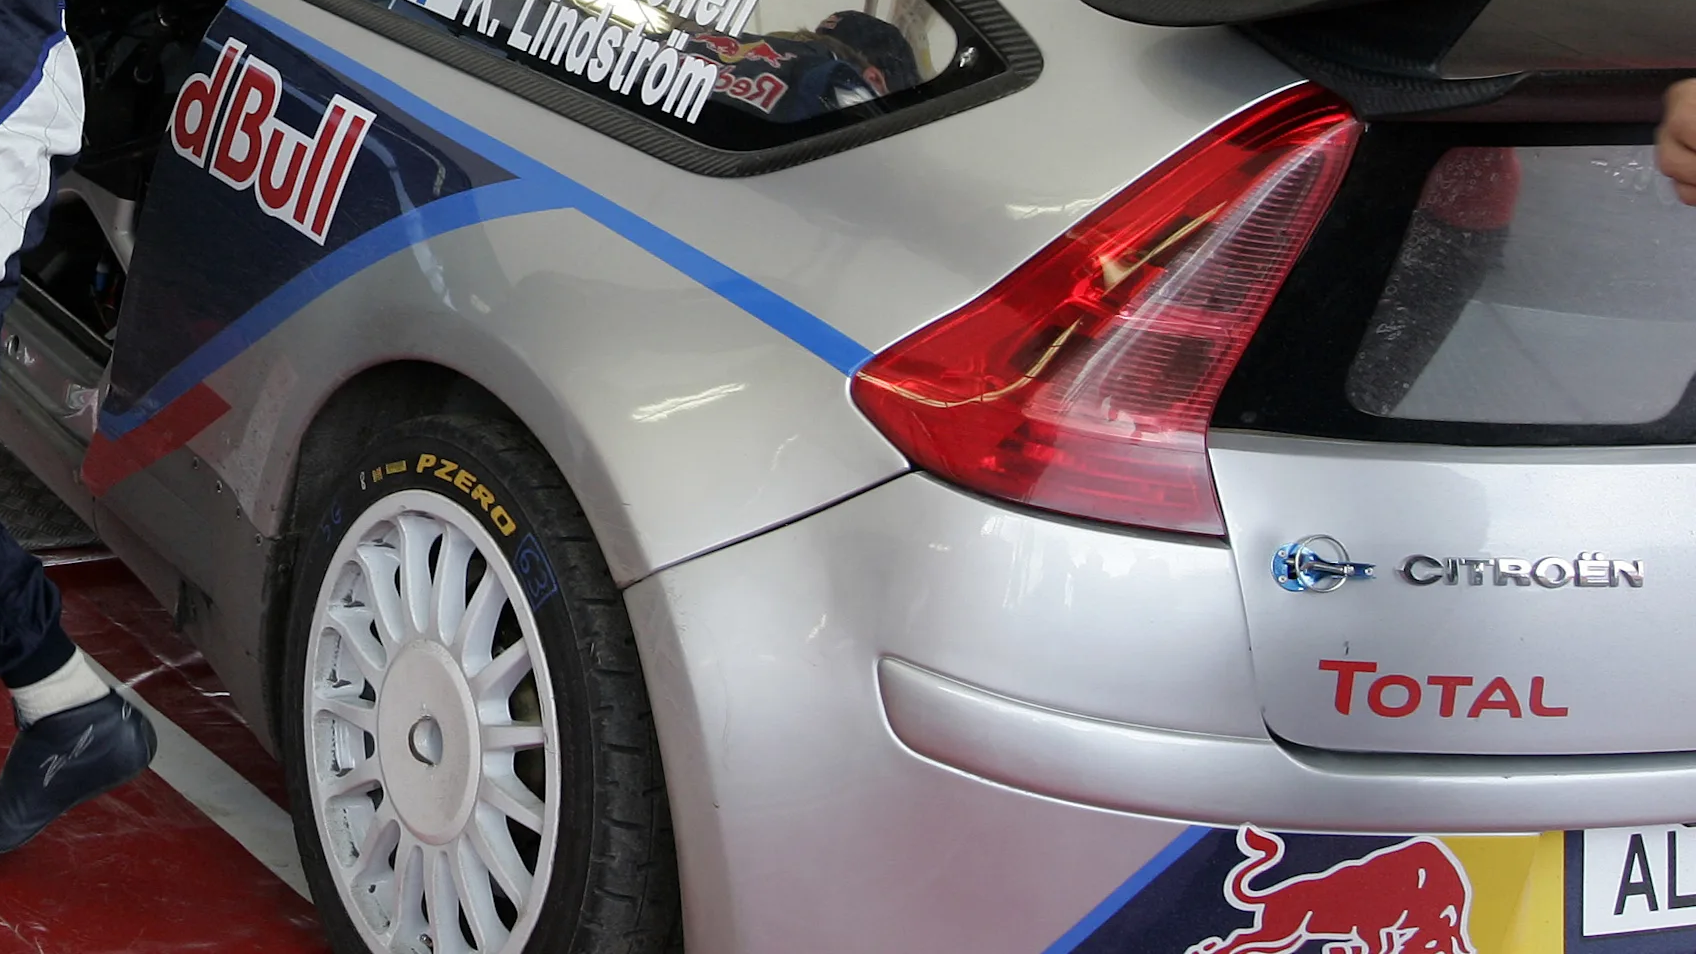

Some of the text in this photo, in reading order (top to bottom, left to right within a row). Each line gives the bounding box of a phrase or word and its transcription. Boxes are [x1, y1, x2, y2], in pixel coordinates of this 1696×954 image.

[1401, 551, 1645, 588] CITROËN
[1317, 659, 1569, 718] TOTAL
[1612, 830, 1696, 916] AL
